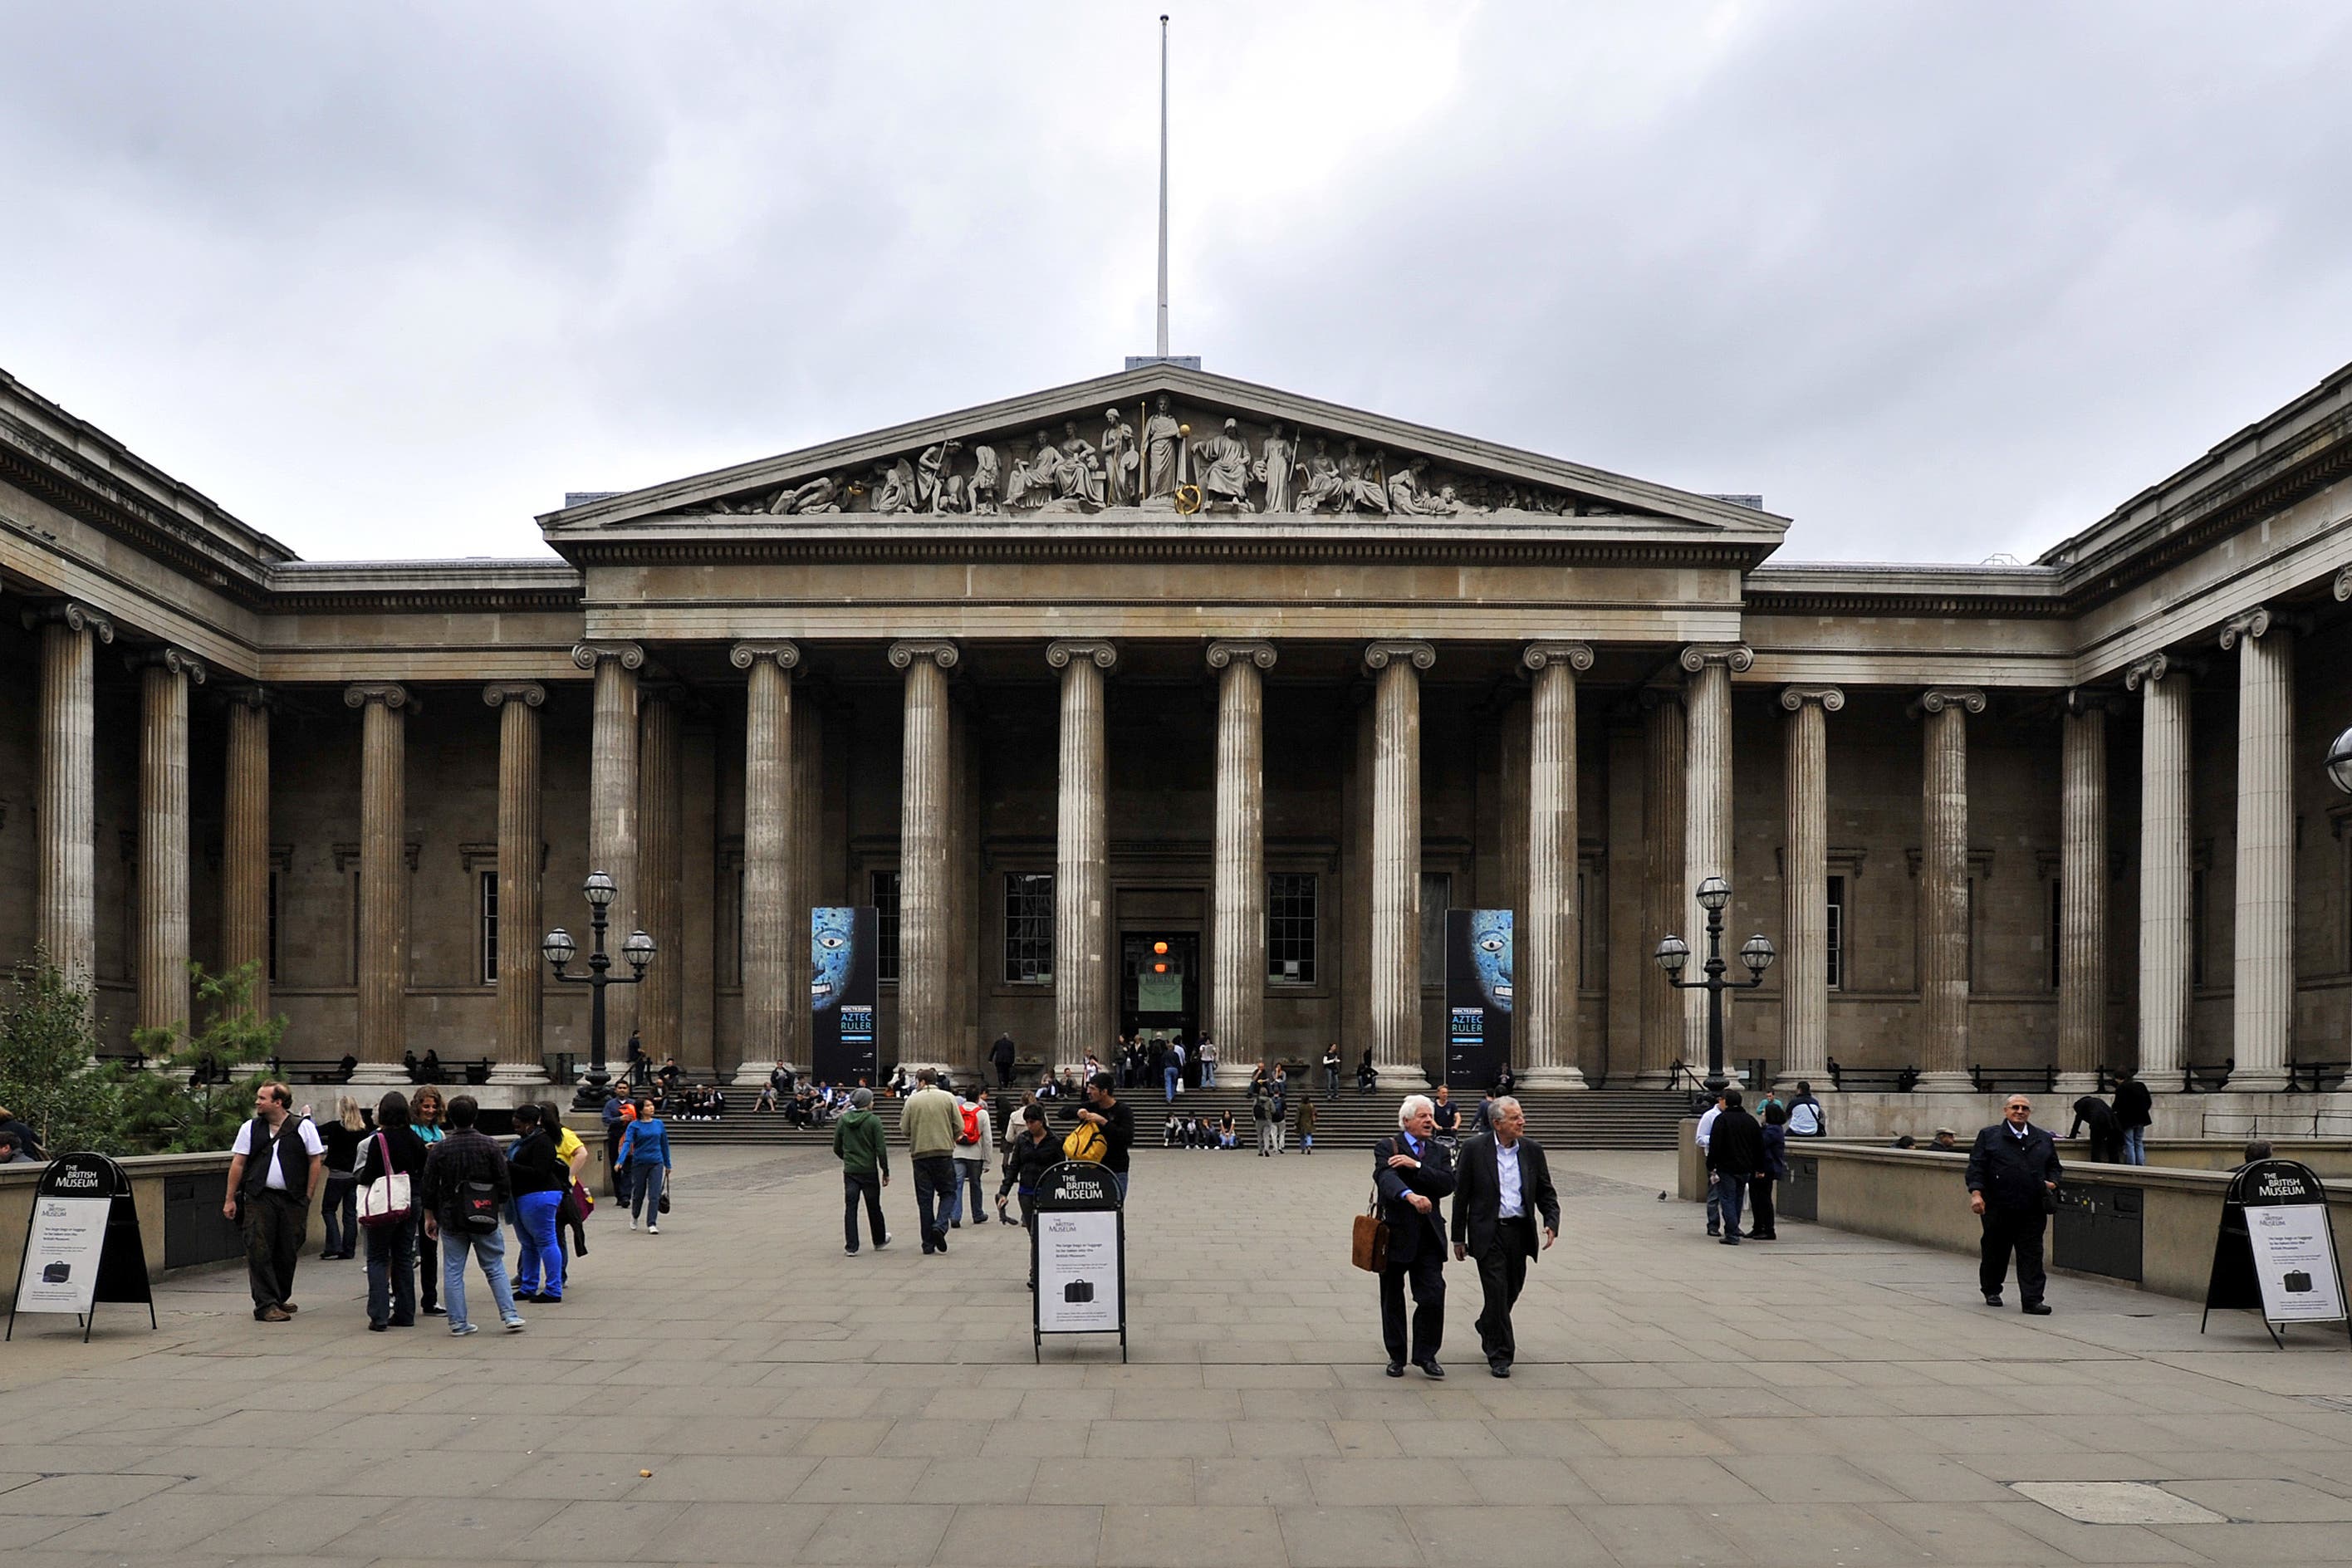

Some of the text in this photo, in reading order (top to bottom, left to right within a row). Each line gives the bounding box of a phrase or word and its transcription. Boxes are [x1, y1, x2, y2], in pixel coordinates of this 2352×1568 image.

[841, 1013, 872, 1022] AZTEC
[841, 1022, 871, 1030] RULER
[1452, 1024, 1482, 1032] RULER
[55, 1177, 98, 1188] MUSEUM
[1066, 1181, 1100, 1189] BRITISH
[2268, 1178, 2301, 1187] BRITISH
[1055, 1188, 1103, 1199] MUSEUM
[2259, 1185, 2305, 1196] MUSEUM
